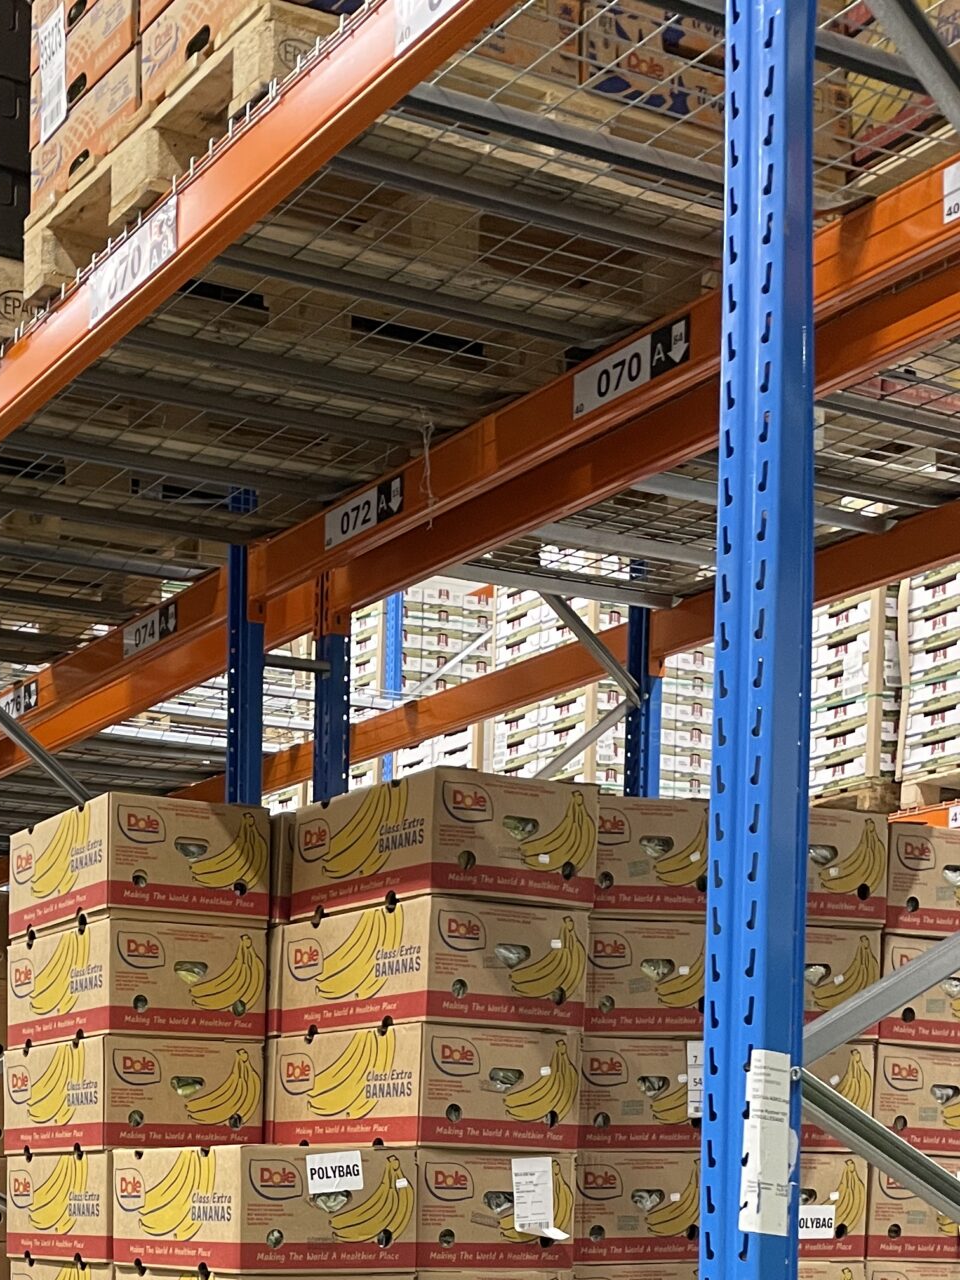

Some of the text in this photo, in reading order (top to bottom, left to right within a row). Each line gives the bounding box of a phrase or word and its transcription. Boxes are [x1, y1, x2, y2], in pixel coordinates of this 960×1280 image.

[946, 203, 960, 217] 40
[597, 352, 642, 398] 070
[652, 342, 665, 367] A
[341, 494, 388, 535] 072 A
[134, 619, 156, 648] 074
[453, 789, 486, 808] Dole
[127, 812, 160, 833] Dole
[403, 818, 424, 830] Extra
[599, 816, 625, 832] Dole
[303, 828, 327, 847] Dole
[379, 828, 424, 853] BANANAS
[904, 841, 931, 858] Dole
[15, 853, 33, 871] Dole
[447, 918, 480, 935] Dole
[126, 938, 160, 955] Dole
[400, 945, 421, 956] Extra
[594, 940, 624, 955] Dole
[293, 946, 320, 966] Dole
[15, 967, 33, 983] Dole
[375, 956, 420, 977] BANANAS
[441, 1044, 474, 1062] Dole
[122, 1056, 155, 1072] Dole
[285, 1061, 312, 1082] Dole
[590, 1059, 622, 1072] Dole
[891, 1063, 918, 1078] Dole
[11, 1073, 29, 1089] Dole
[391, 1070, 412, 1079] Extra
[365, 1081, 412, 1099] BANANAS
[259, 1167, 297, 1185] Dole
[310, 1163, 360, 1181] POLYBAG
[434, 1170, 468, 1187] Dole
[584, 1171, 617, 1188] Dole
[13, 1177, 30, 1194] Dole
[119, 1176, 142, 1197] Dole
[212, 1193, 232, 1203] Extra
[191, 1205, 232, 1222] BANANAS
[798, 1215, 833, 1230] OLYBAG
